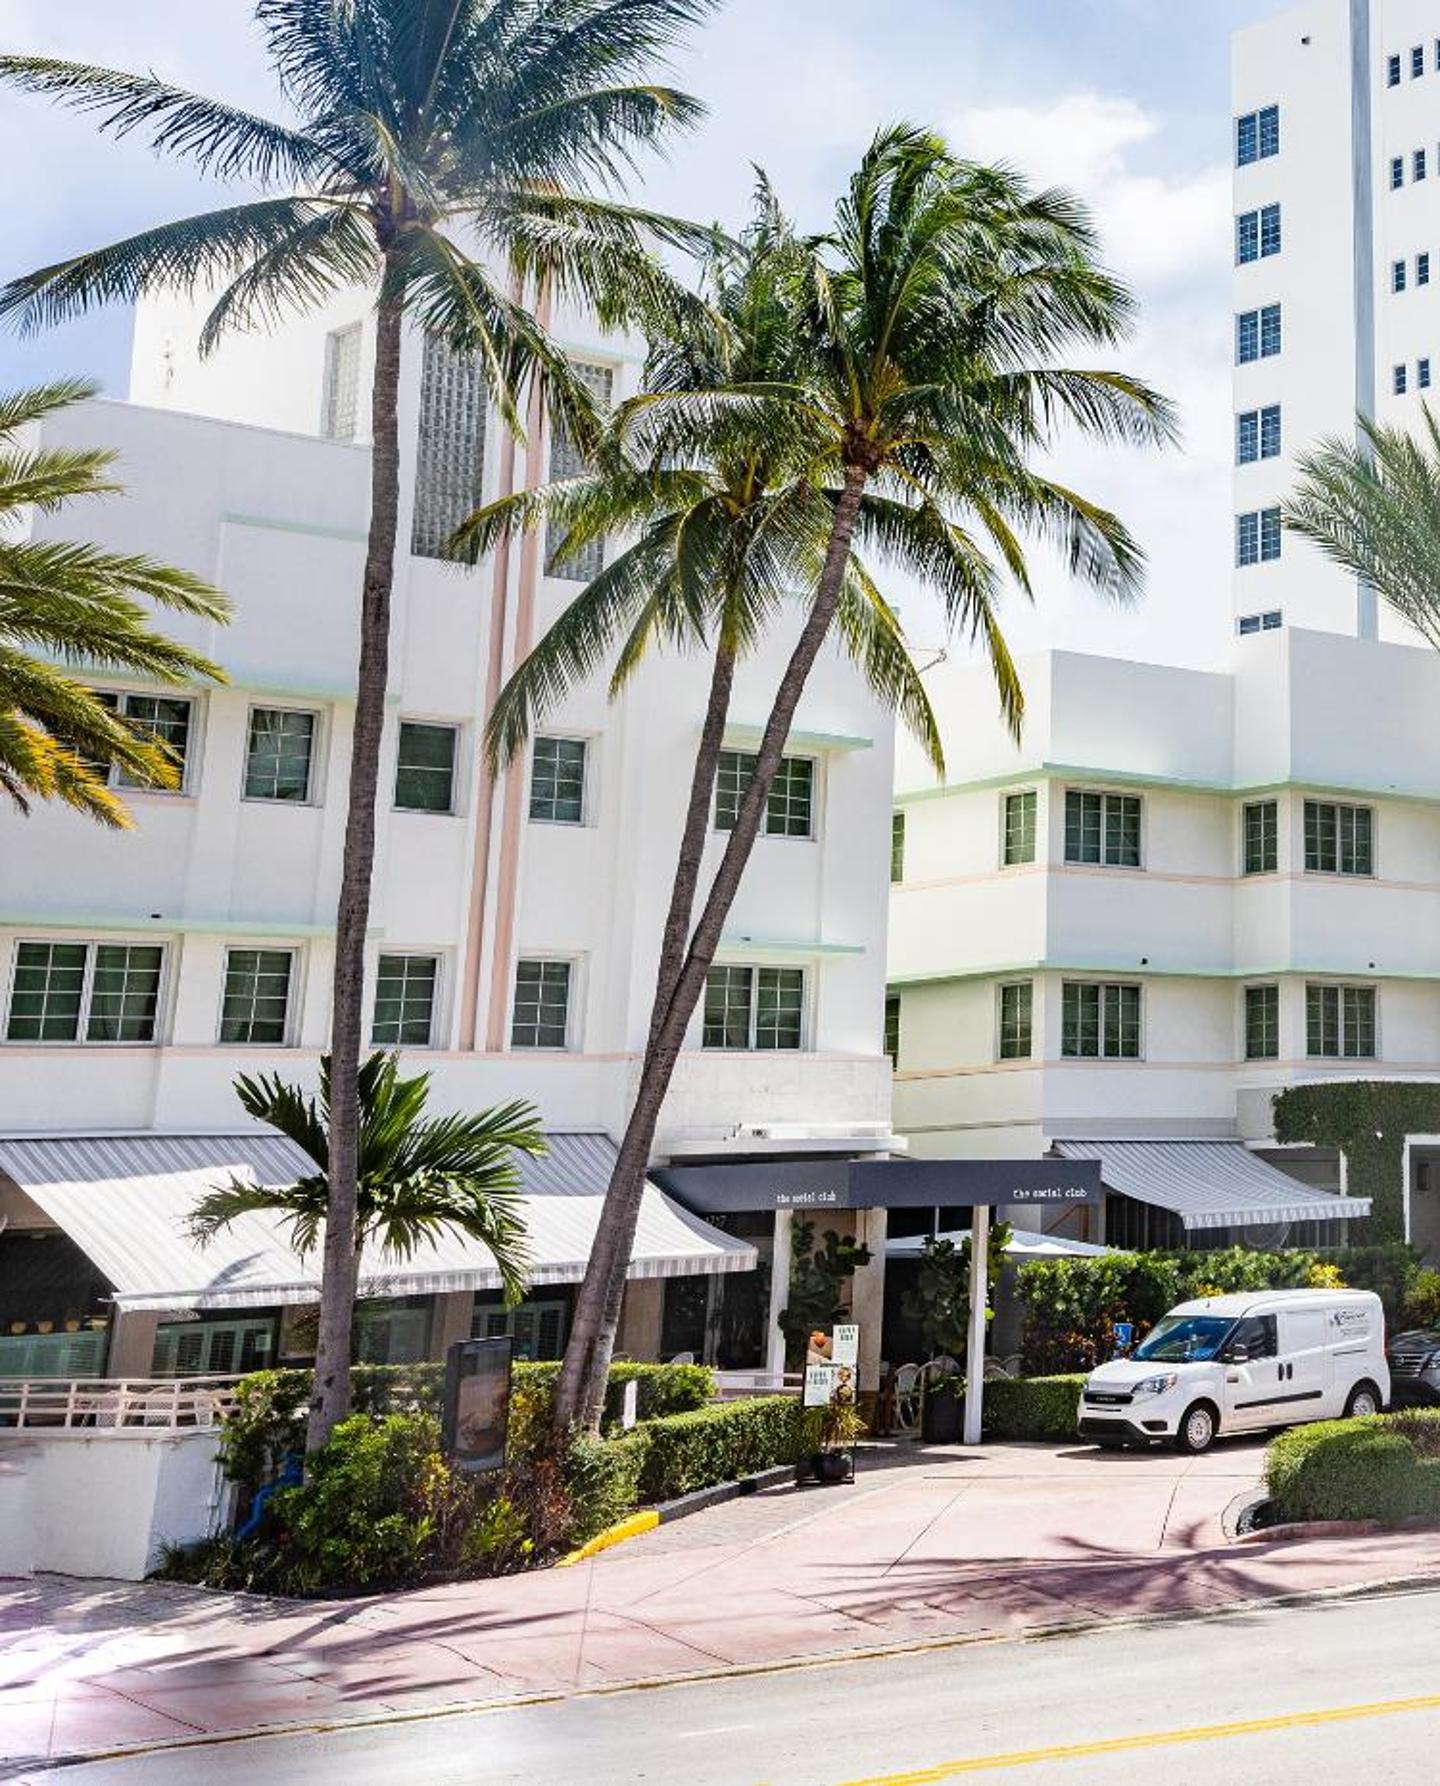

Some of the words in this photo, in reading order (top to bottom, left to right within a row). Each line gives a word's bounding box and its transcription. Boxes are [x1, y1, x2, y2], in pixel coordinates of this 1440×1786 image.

[777, 1193, 790, 1203] the
[818, 1190, 836, 1201] club
[1013, 1188, 1030, 1199] the
[1065, 1187, 1088, 1198] club
